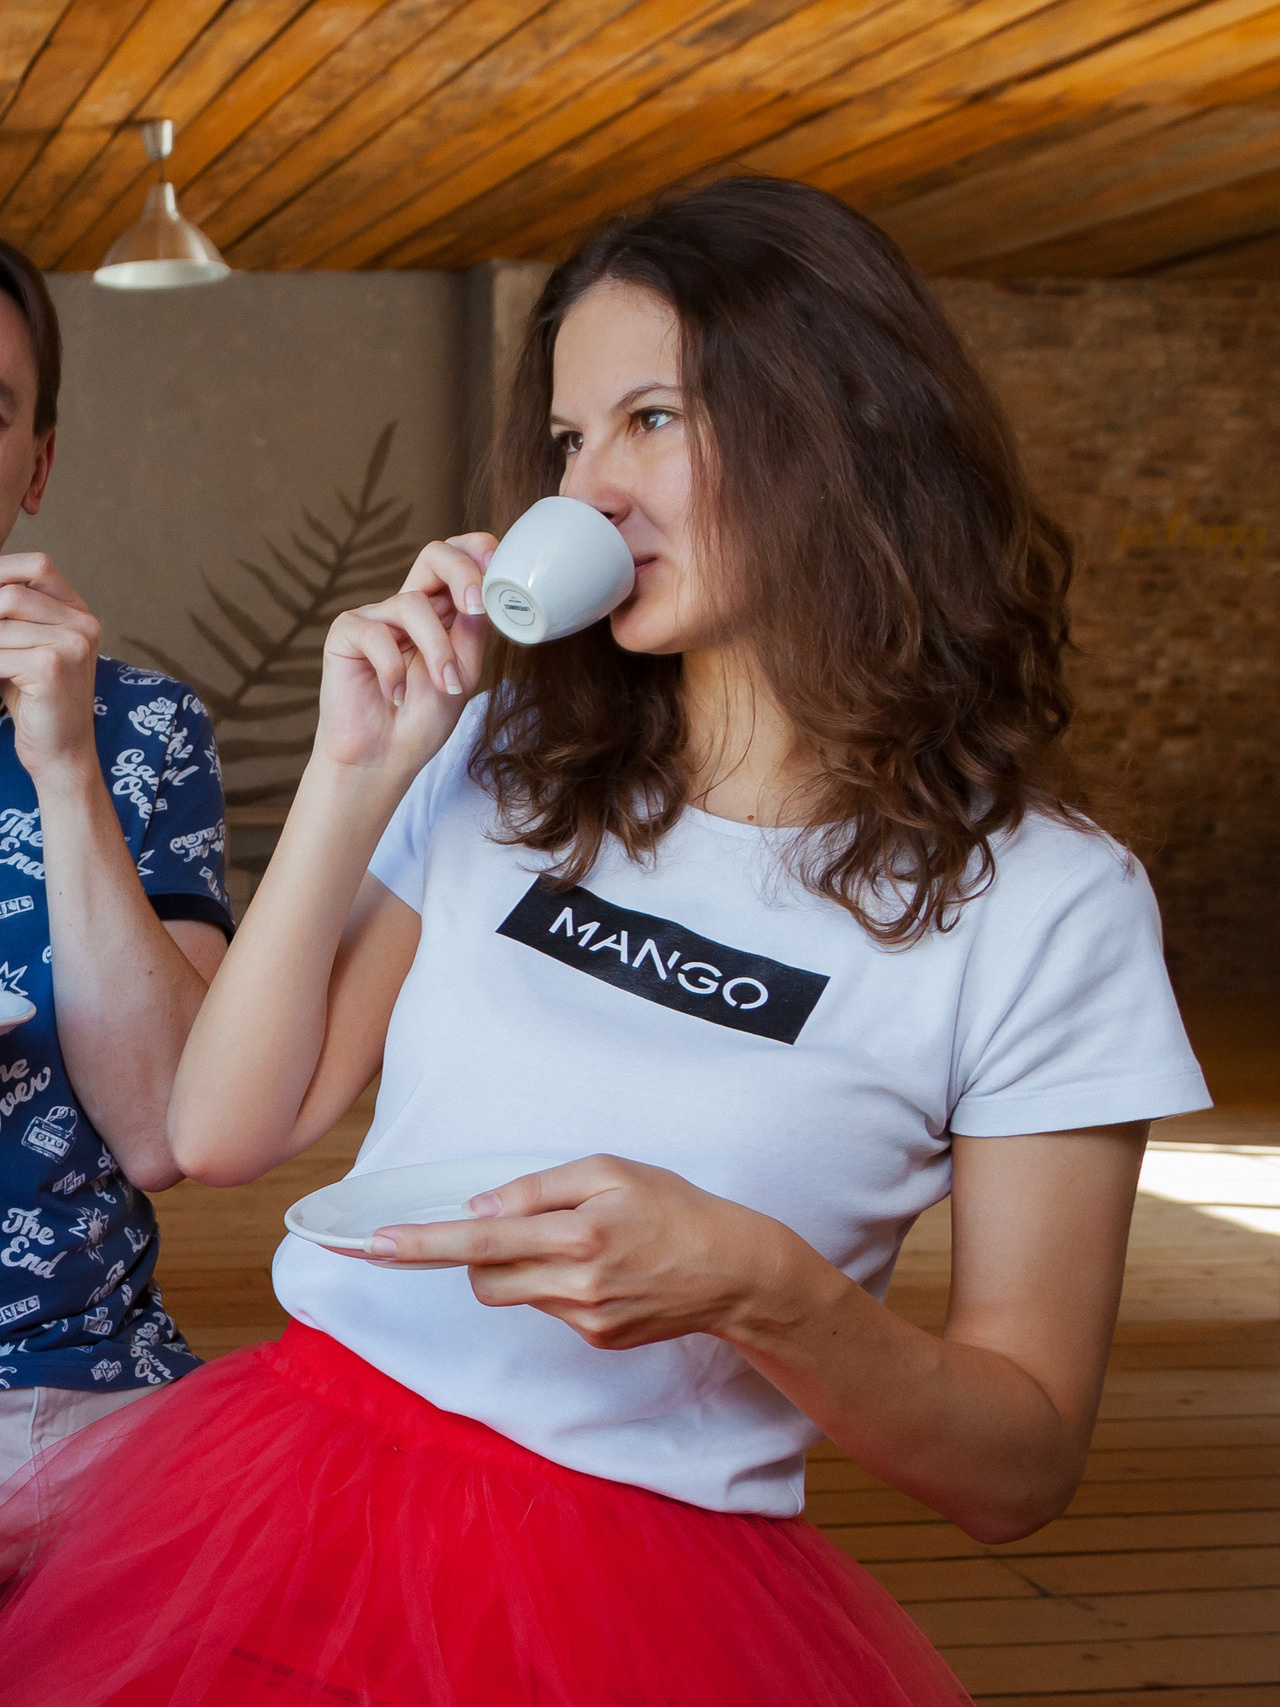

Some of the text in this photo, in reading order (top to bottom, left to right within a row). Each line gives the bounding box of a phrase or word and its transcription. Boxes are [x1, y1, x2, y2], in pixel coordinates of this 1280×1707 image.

[549, 907, 769, 1010] MANGO
[2, 1207, 55, 1245] The
[0, 1235, 68, 1279] End
